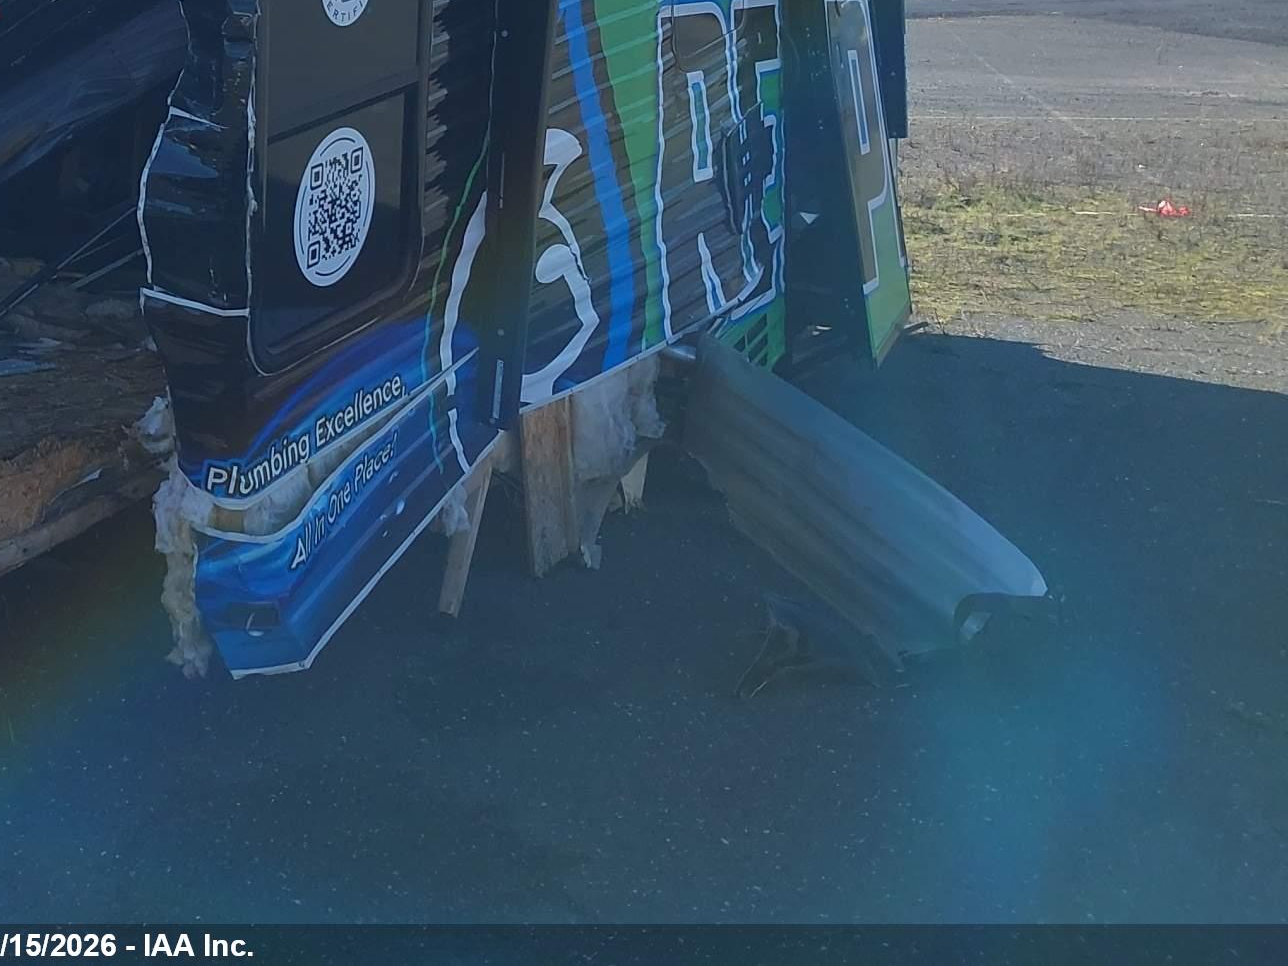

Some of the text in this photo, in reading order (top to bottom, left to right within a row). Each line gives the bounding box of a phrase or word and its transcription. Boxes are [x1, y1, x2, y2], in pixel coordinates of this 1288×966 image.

[206, 374, 407, 495] Plumbing Excellence,
[290, 432, 399, 570] All In One Place!
